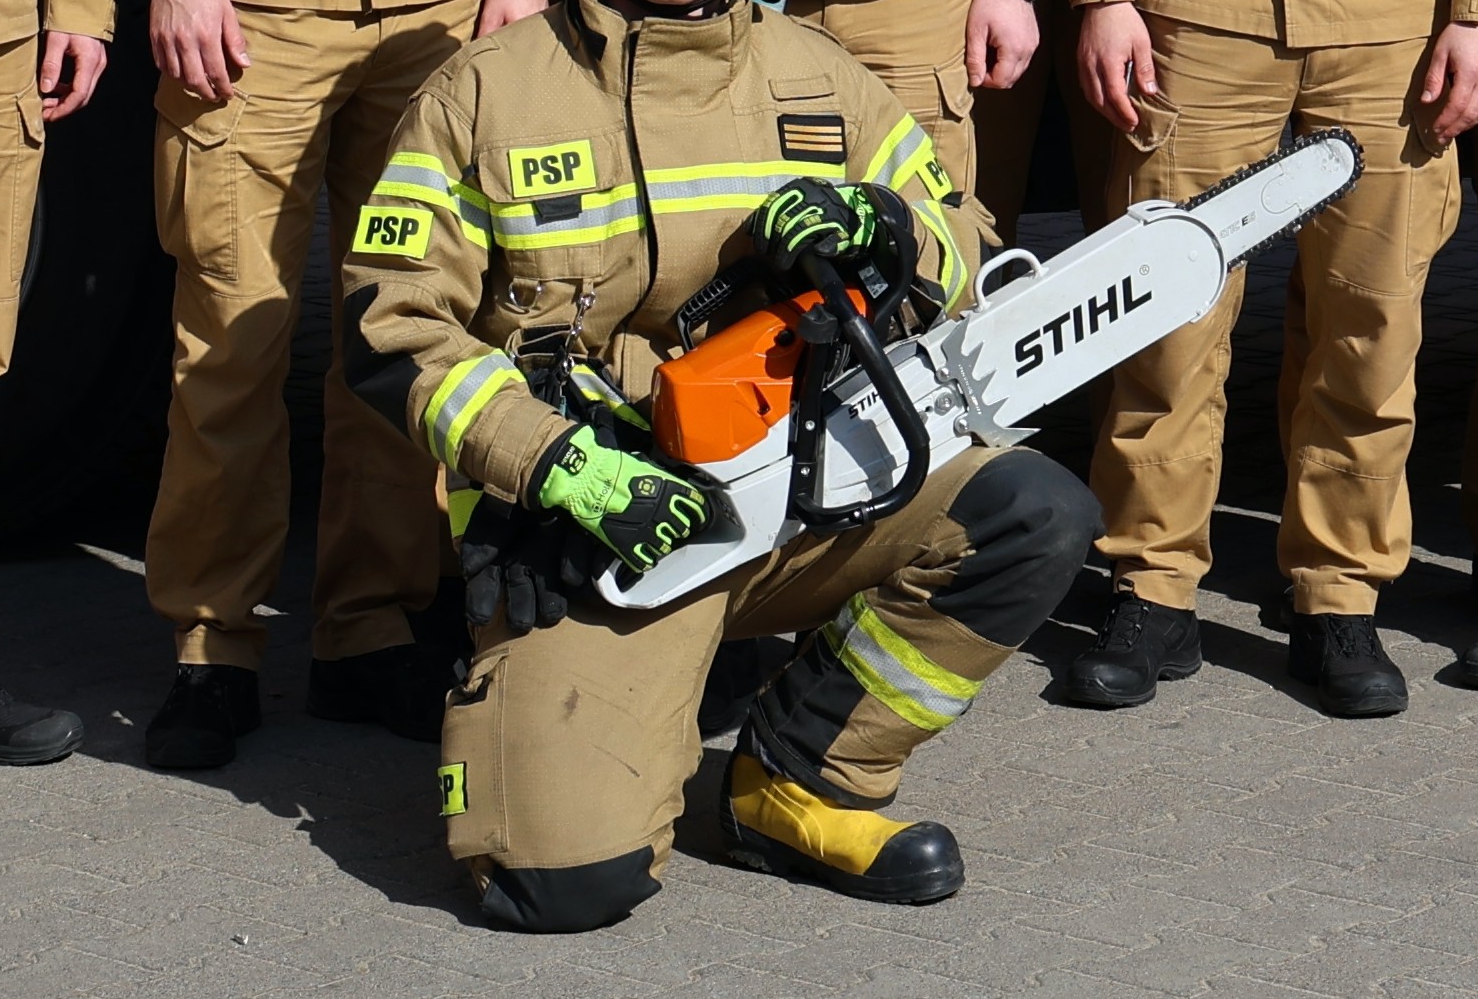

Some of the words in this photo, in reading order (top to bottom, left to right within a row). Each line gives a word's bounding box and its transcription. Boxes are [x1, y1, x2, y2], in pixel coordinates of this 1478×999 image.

[521, 151, 582, 188] PSP
[364, 215, 420, 247] PSP
[1014, 274, 1153, 379] STIHL
[848, 388, 883, 420] STIH
